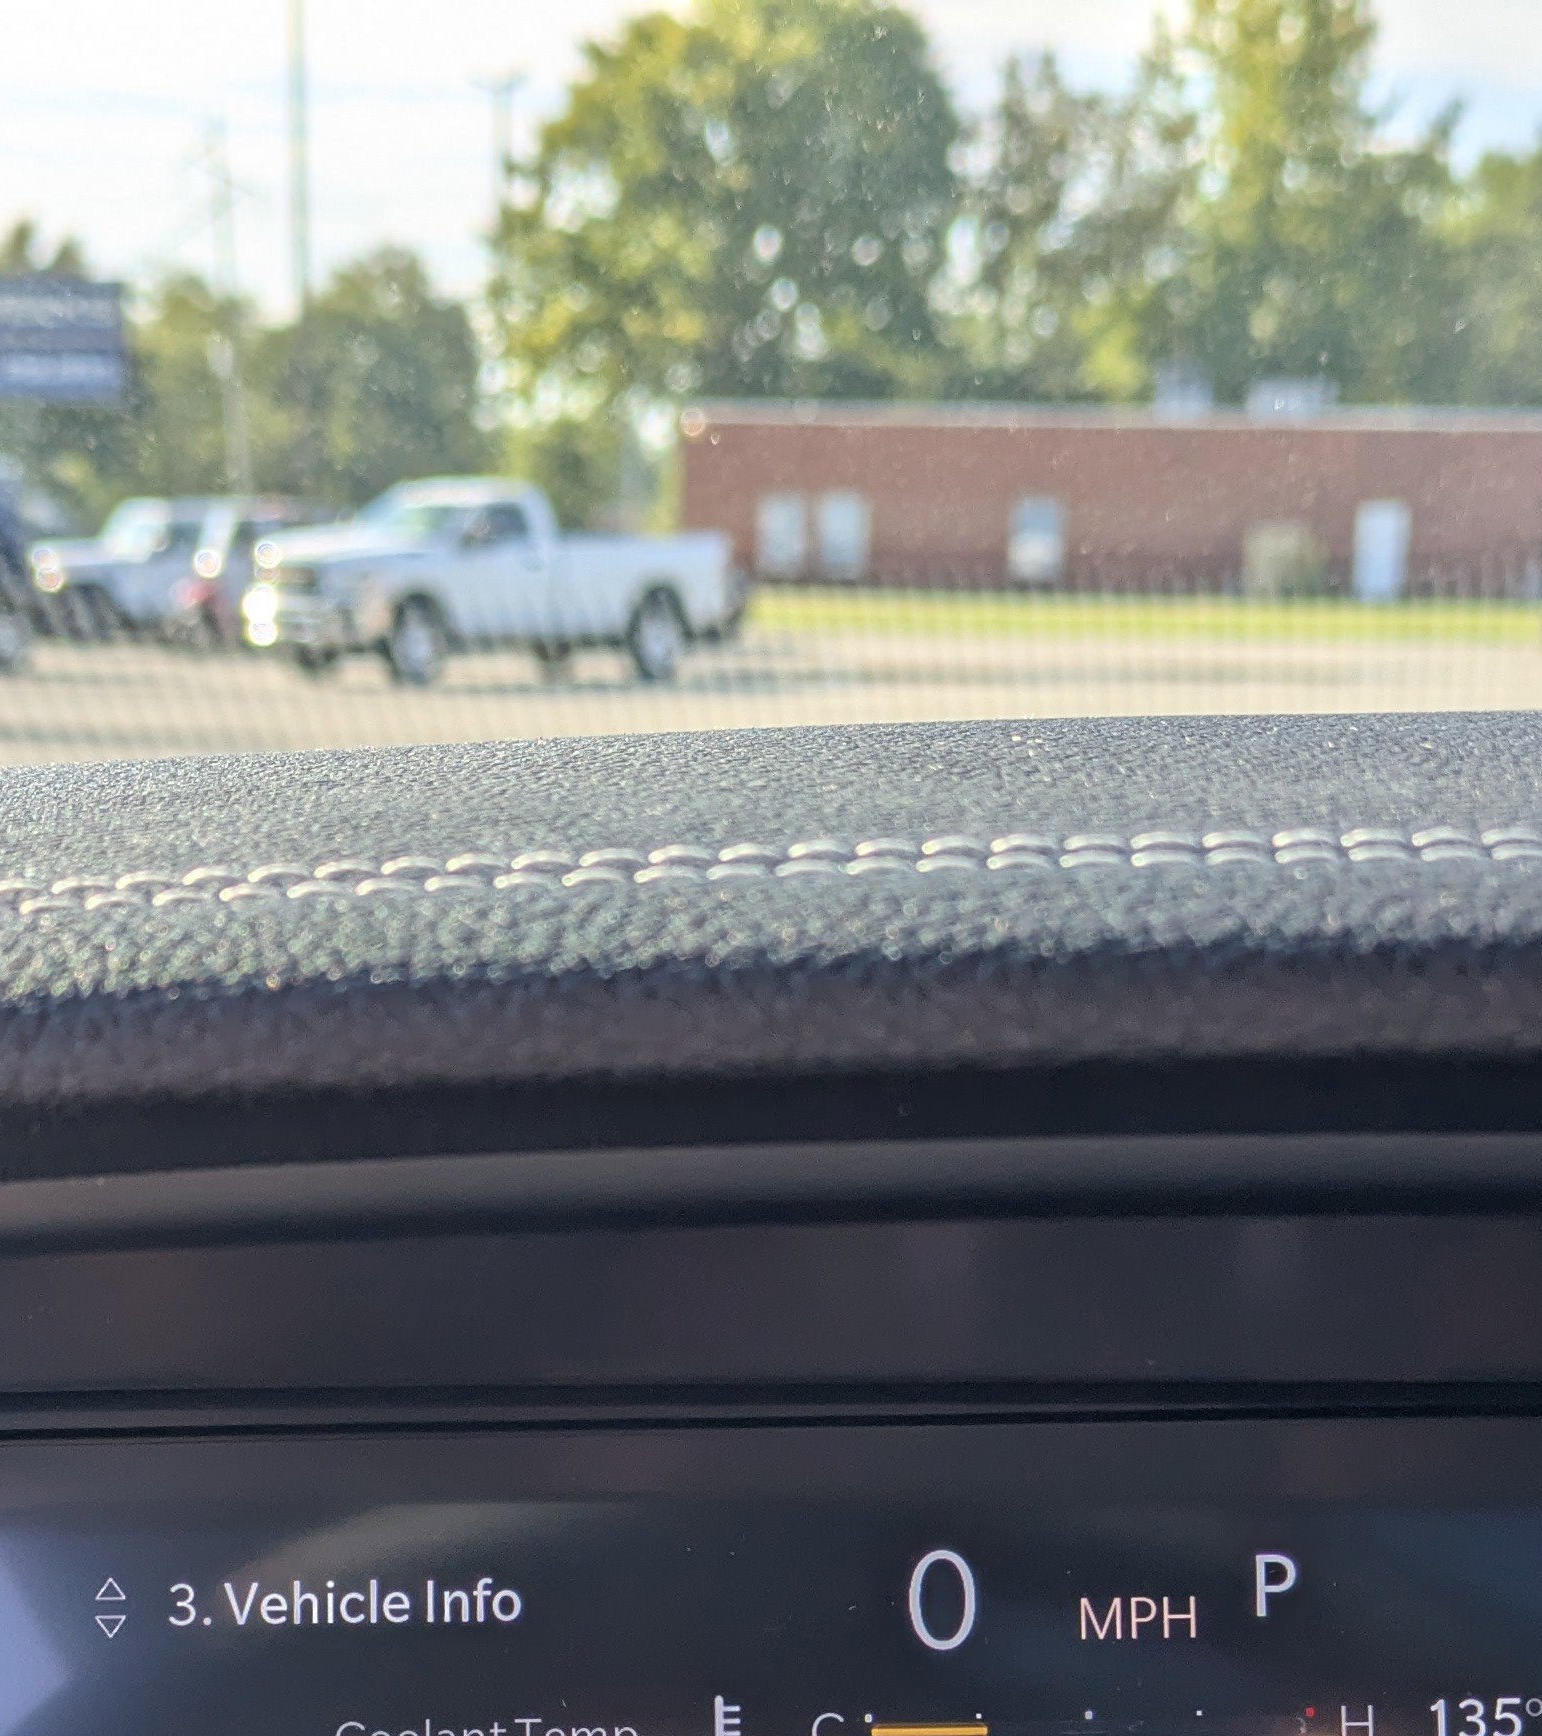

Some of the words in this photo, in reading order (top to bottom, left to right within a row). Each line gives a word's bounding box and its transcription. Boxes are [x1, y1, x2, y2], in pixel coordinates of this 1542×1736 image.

[168, 1583, 212, 1626] 3.
[225, 1578, 410, 1625] Vehicle
[427, 1577, 522, 1623] Info
[908, 1549, 976, 1651] 0
[1256, 1554, 1297, 1617] P
[1079, 1595, 1198, 1639] MPH
